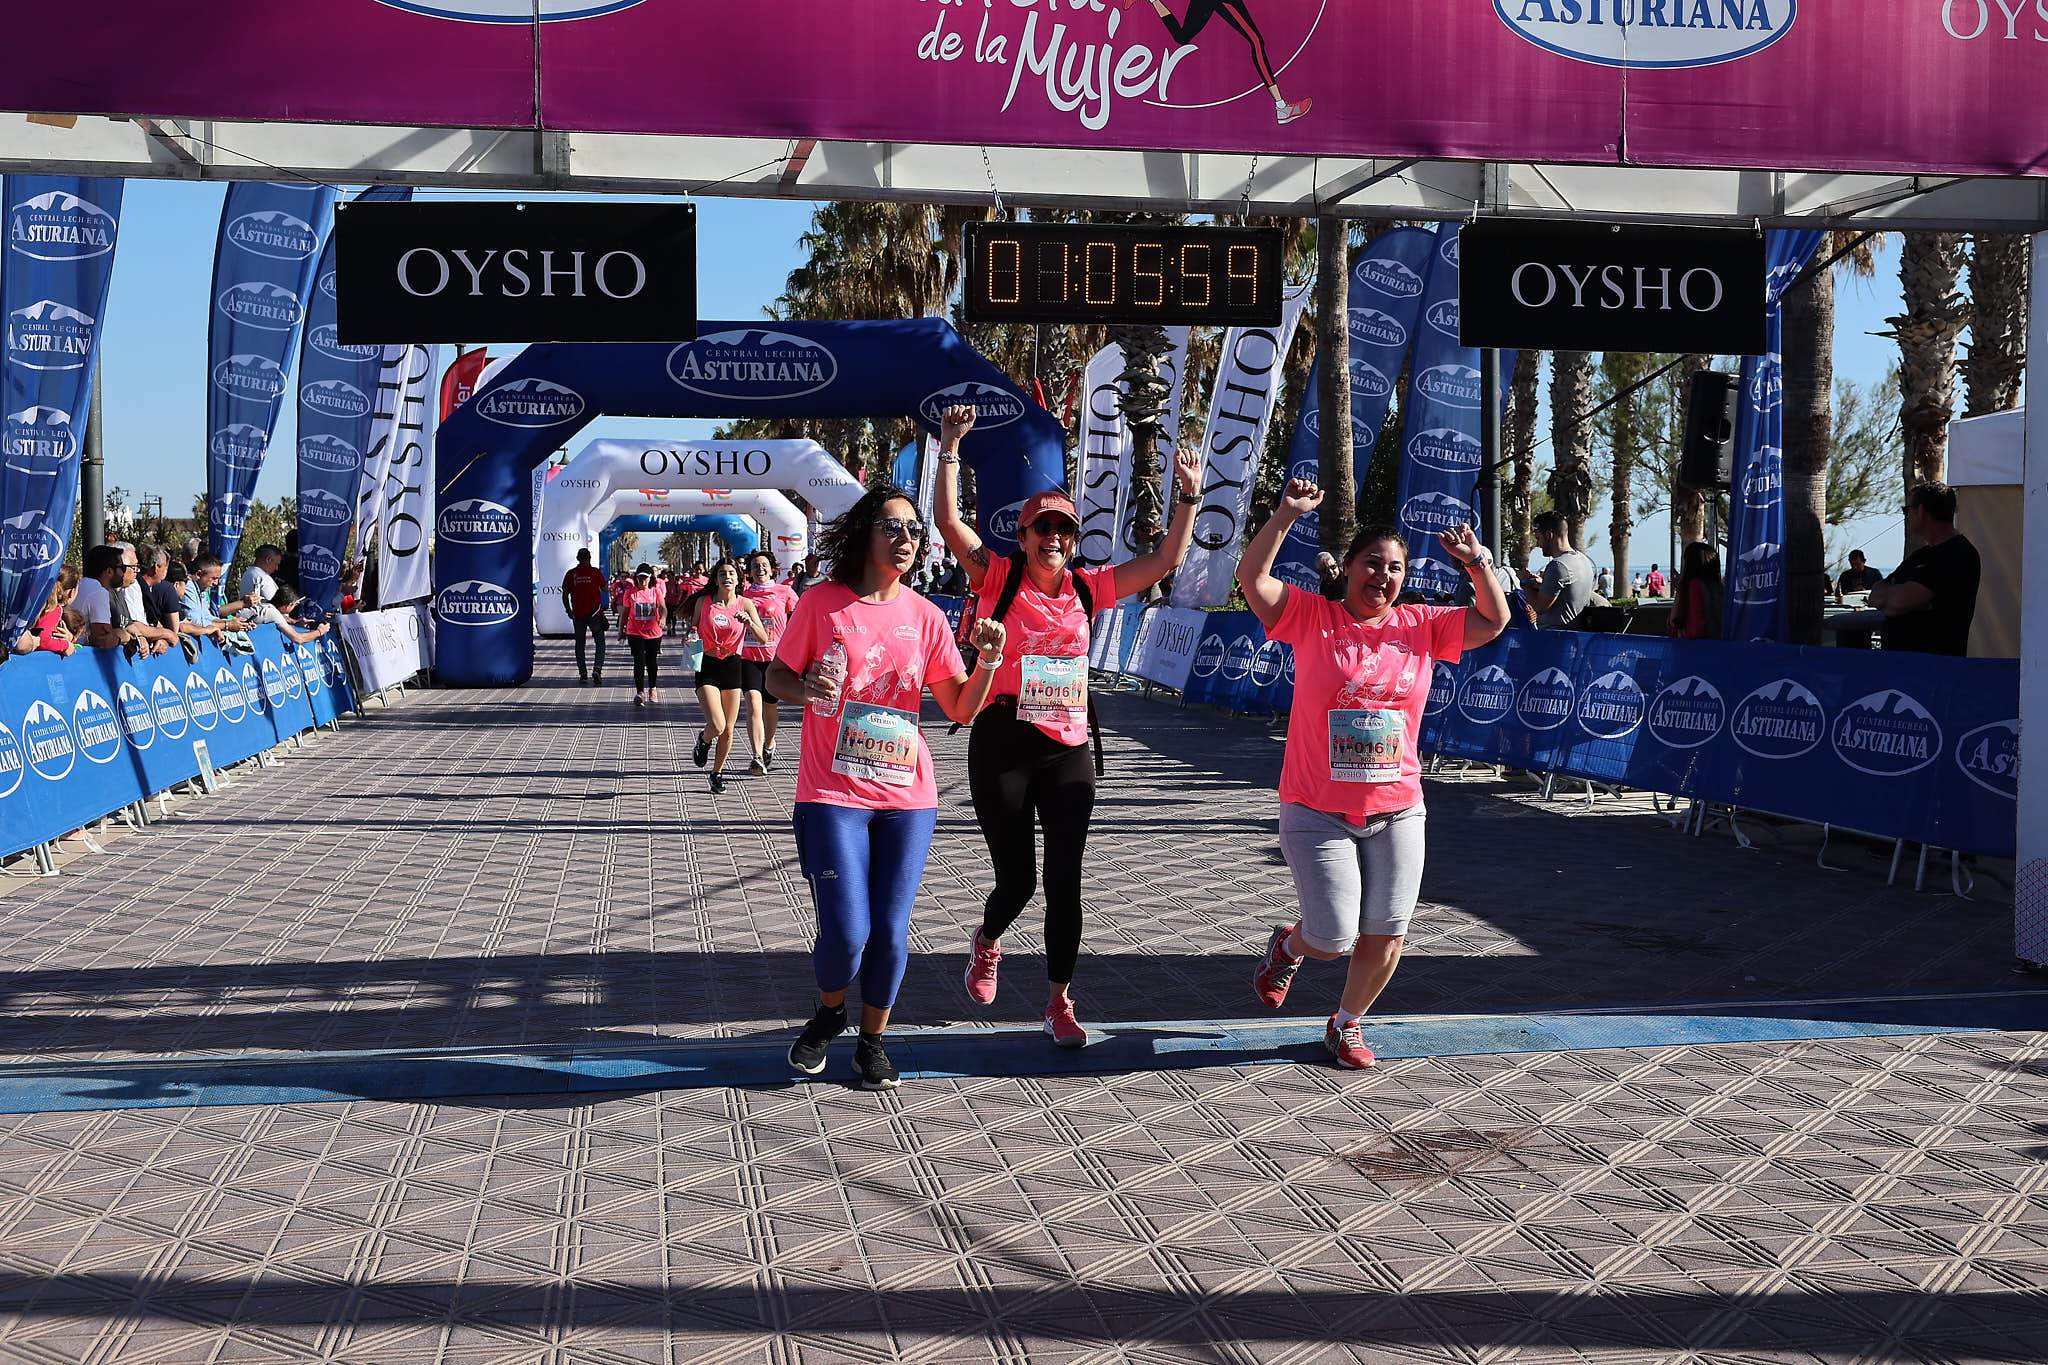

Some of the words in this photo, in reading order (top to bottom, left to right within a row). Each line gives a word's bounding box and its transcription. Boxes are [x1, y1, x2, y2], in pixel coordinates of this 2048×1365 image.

[918, 10, 964, 61] de
[975, 10, 1008, 65] la
[1001, 7, 1199, 130] Mujer
[12, 215, 109, 247] ASTURIANA
[234, 222, 312, 252] ASTURIANA
[397, 247, 647, 299] OYSHO
[1359, 264, 1418, 294] ASTURIANA
[1511, 262, 1724, 312] OYSHO
[1348, 316, 1401, 344] STURIANA
[680, 350, 825, 381] ASTURIANA
[705, 349, 760, 358] CENTRAL
[764, 350, 819, 358] LECHERA
[306, 389, 364, 413] ASTURIANA
[482, 396, 577, 416] ASTURIANA
[1193, 328, 1279, 551] OYSHO
[639, 449, 773, 476] OYSHO
[1080, 384, 1122, 566] OYSHO
[560, 479, 601, 489] OYSHO
[809, 478, 848, 487] OYSHO
[441, 516, 515, 534] ASTURIANA
[543, 532, 581, 542] OYSHO
[440, 597, 514, 615] ASTURIANA
[1156, 619, 1194, 656] OYSHO
[1044, 686, 1070, 698] 016
[1461, 687, 1508, 711] ASTURIANA
[1519, 690, 1569, 716] ASTURIANA
[1581, 697, 1638, 724] ASTURIANA
[1652, 704, 1718, 732] ASTURIANA
[1736, 706, 1816, 742] ASTURIANA
[81, 720, 119, 748] ASTURIANA
[864, 738, 895, 754] 016
[1354, 742, 1384, 754] 016
[1838, 716, 1929, 759] ASTURIANA
[29, 734, 73, 764] ASTURIANA
